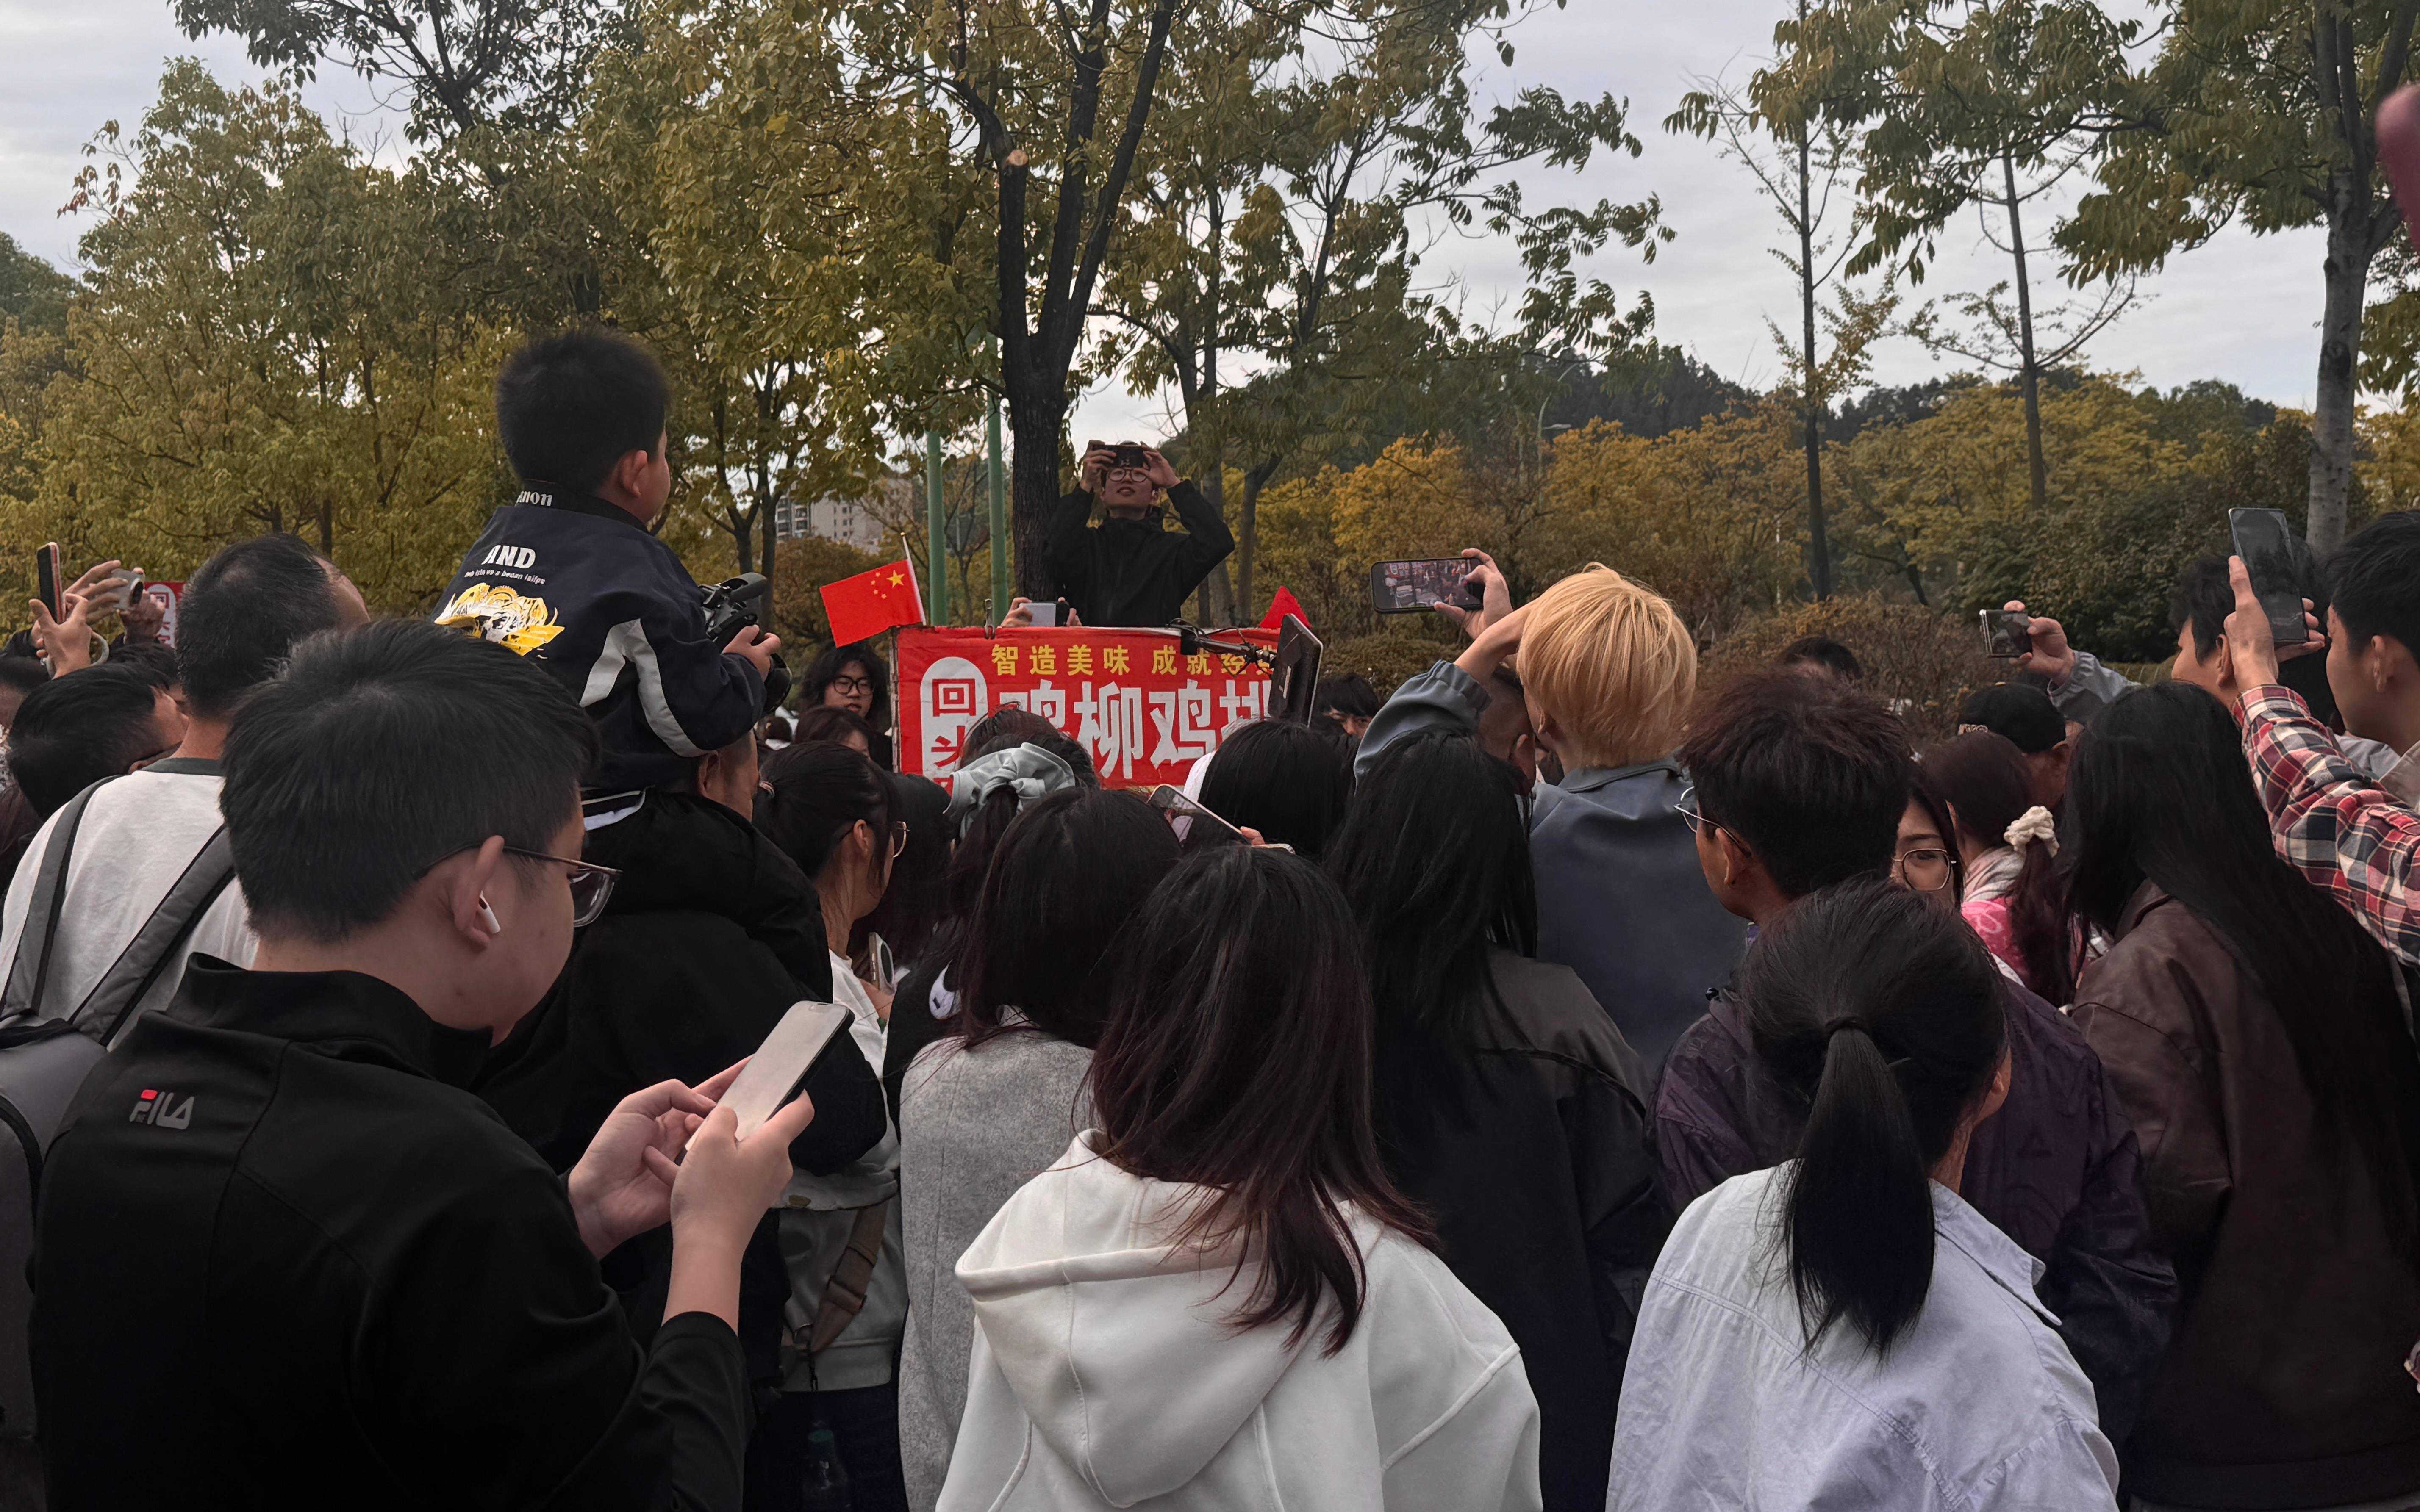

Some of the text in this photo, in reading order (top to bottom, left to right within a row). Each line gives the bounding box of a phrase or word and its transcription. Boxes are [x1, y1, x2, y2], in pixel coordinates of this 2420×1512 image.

[481, 545, 536, 568] AND
[991, 644, 1131, 676] 智造美味
[931, 678, 976, 798] 回头
[129, 1089, 194, 1130] FILA
